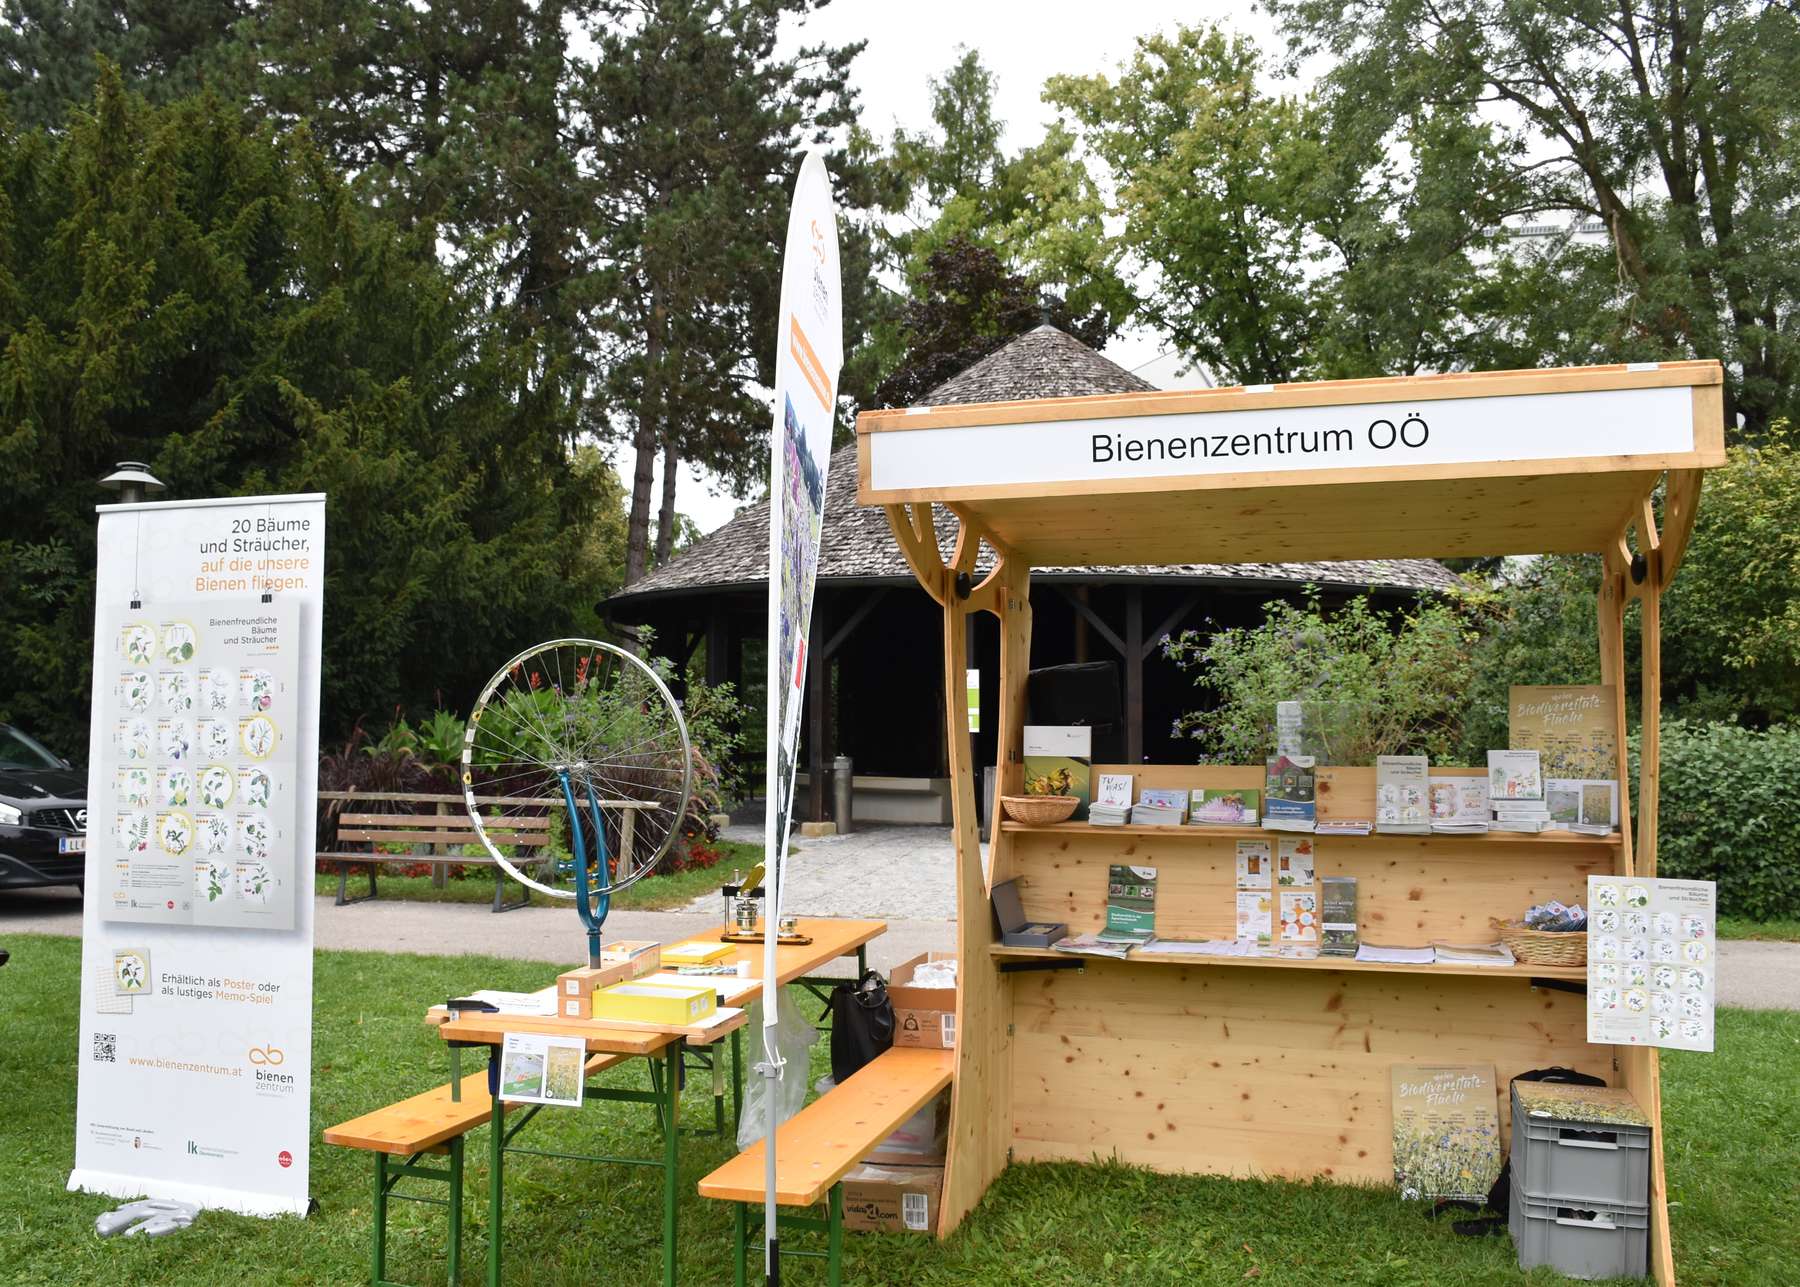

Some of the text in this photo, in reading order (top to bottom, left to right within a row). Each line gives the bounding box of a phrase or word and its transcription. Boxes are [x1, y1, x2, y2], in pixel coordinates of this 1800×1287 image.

[1091, 412, 1430, 463] Bienenzentrum OÖ
[232, 517, 311, 534] 20 Bäume
[200, 536, 310, 554] und Sträucher,
[201, 556, 310, 573] auf die unsere
[196, 575, 308, 592] Bienen fliegen.
[209, 616, 278, 627] Bienenfreundliche
[251, 626, 278, 635] Bäume
[223, 635, 277, 645] und Sträucher
[161, 973, 280, 993] Erhältlich als Poster oder
[161, 985, 273, 1005] als lustiges Memo-Spiel
[128, 1057, 243, 1077] www.bienenzentrum.at
[255, 1069, 294, 1084] bienen
[255, 1081, 294, 1094] zentrum
